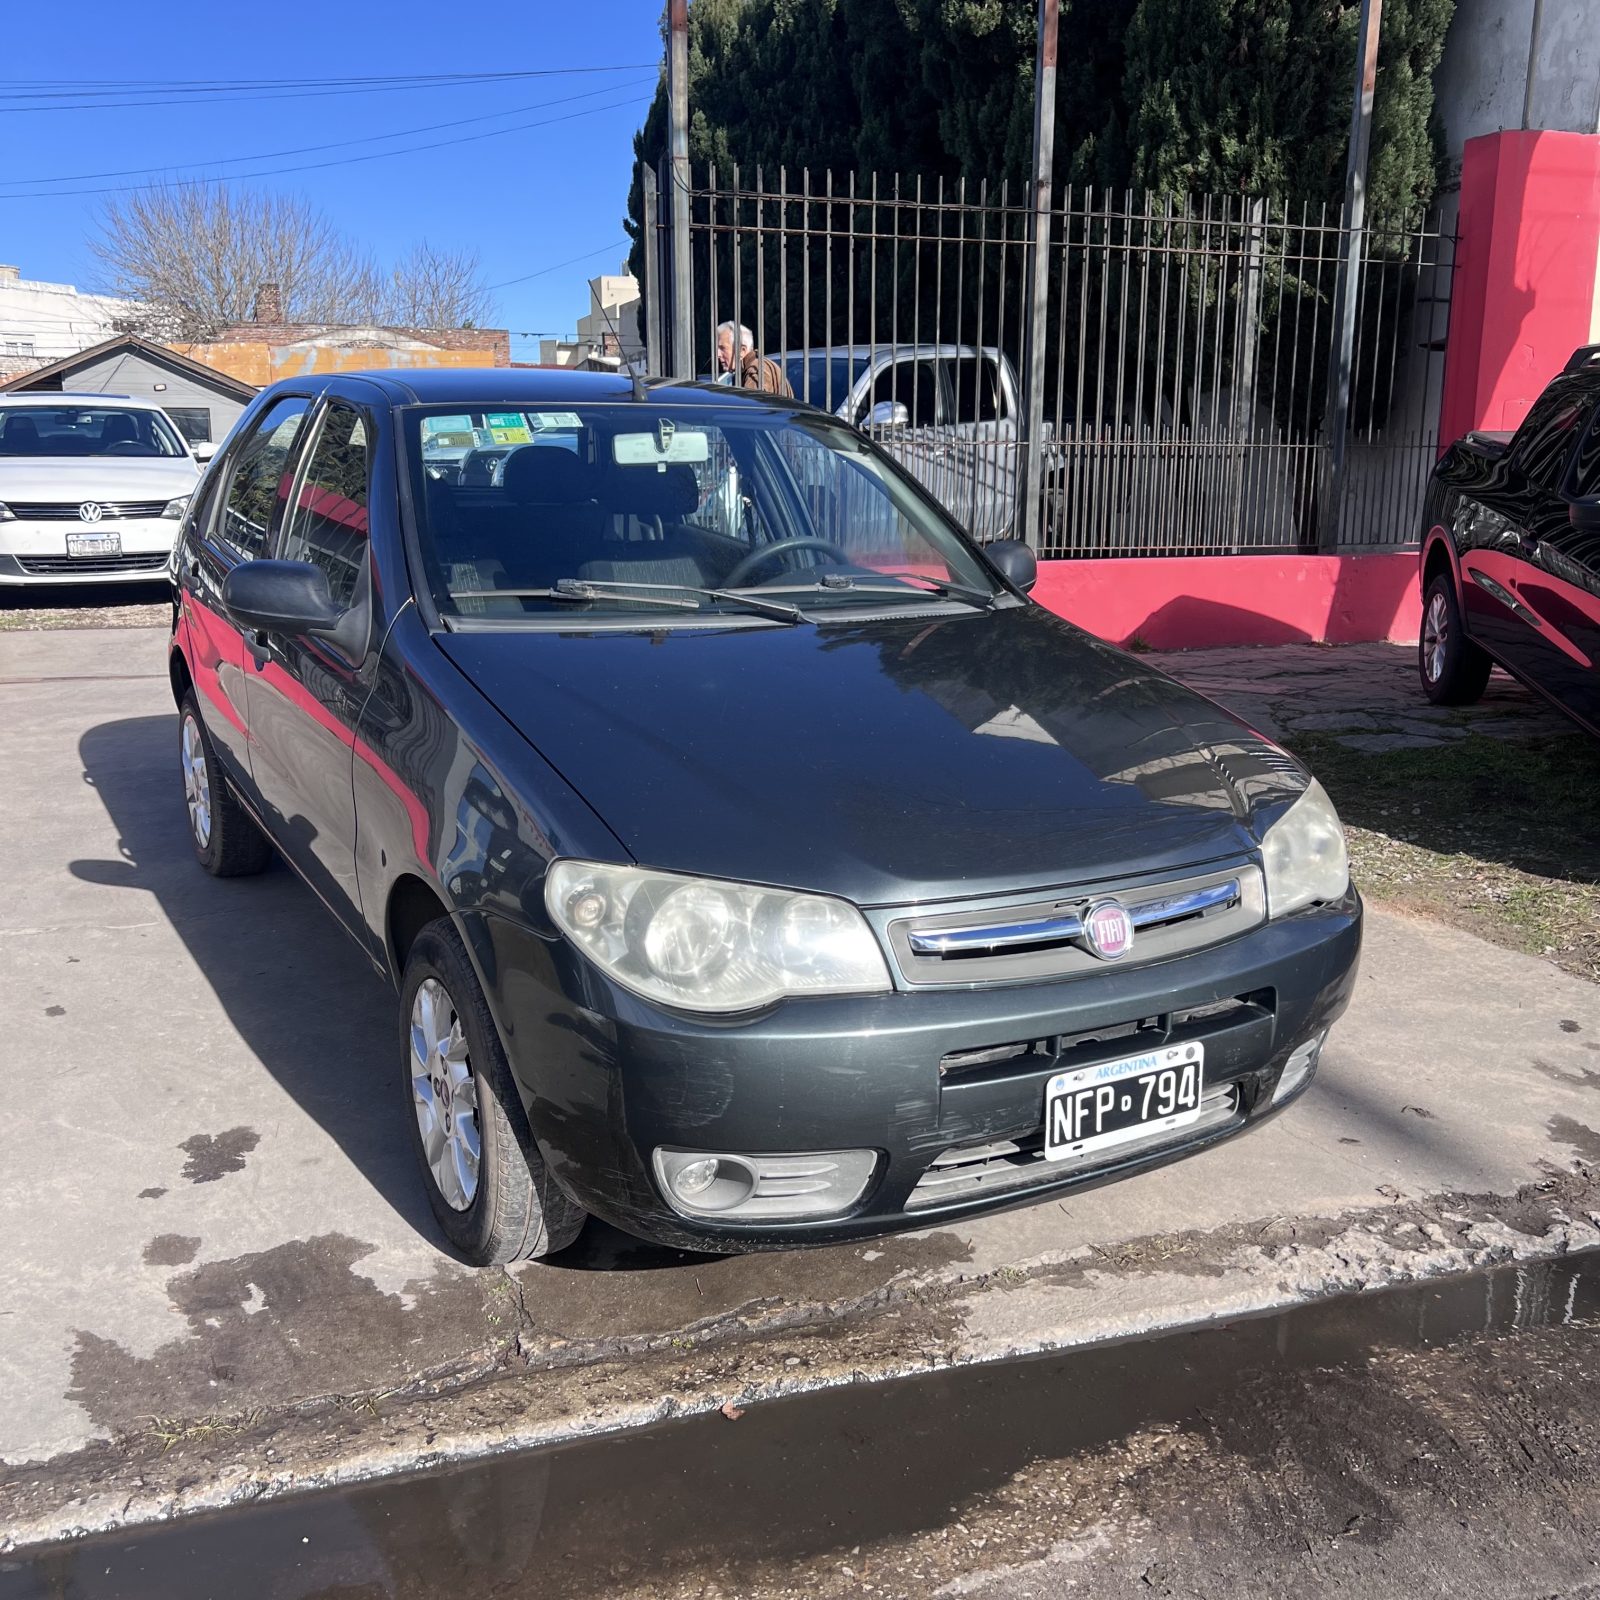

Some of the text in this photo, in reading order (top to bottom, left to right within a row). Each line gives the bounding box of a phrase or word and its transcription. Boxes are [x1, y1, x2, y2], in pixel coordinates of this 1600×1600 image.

[1098, 918, 1124, 944] FIAT
[1096, 1056, 1158, 1079] ARGENTINA
[1054, 1086, 1115, 1143] NFP
[1139, 1065, 1195, 1120] 794
